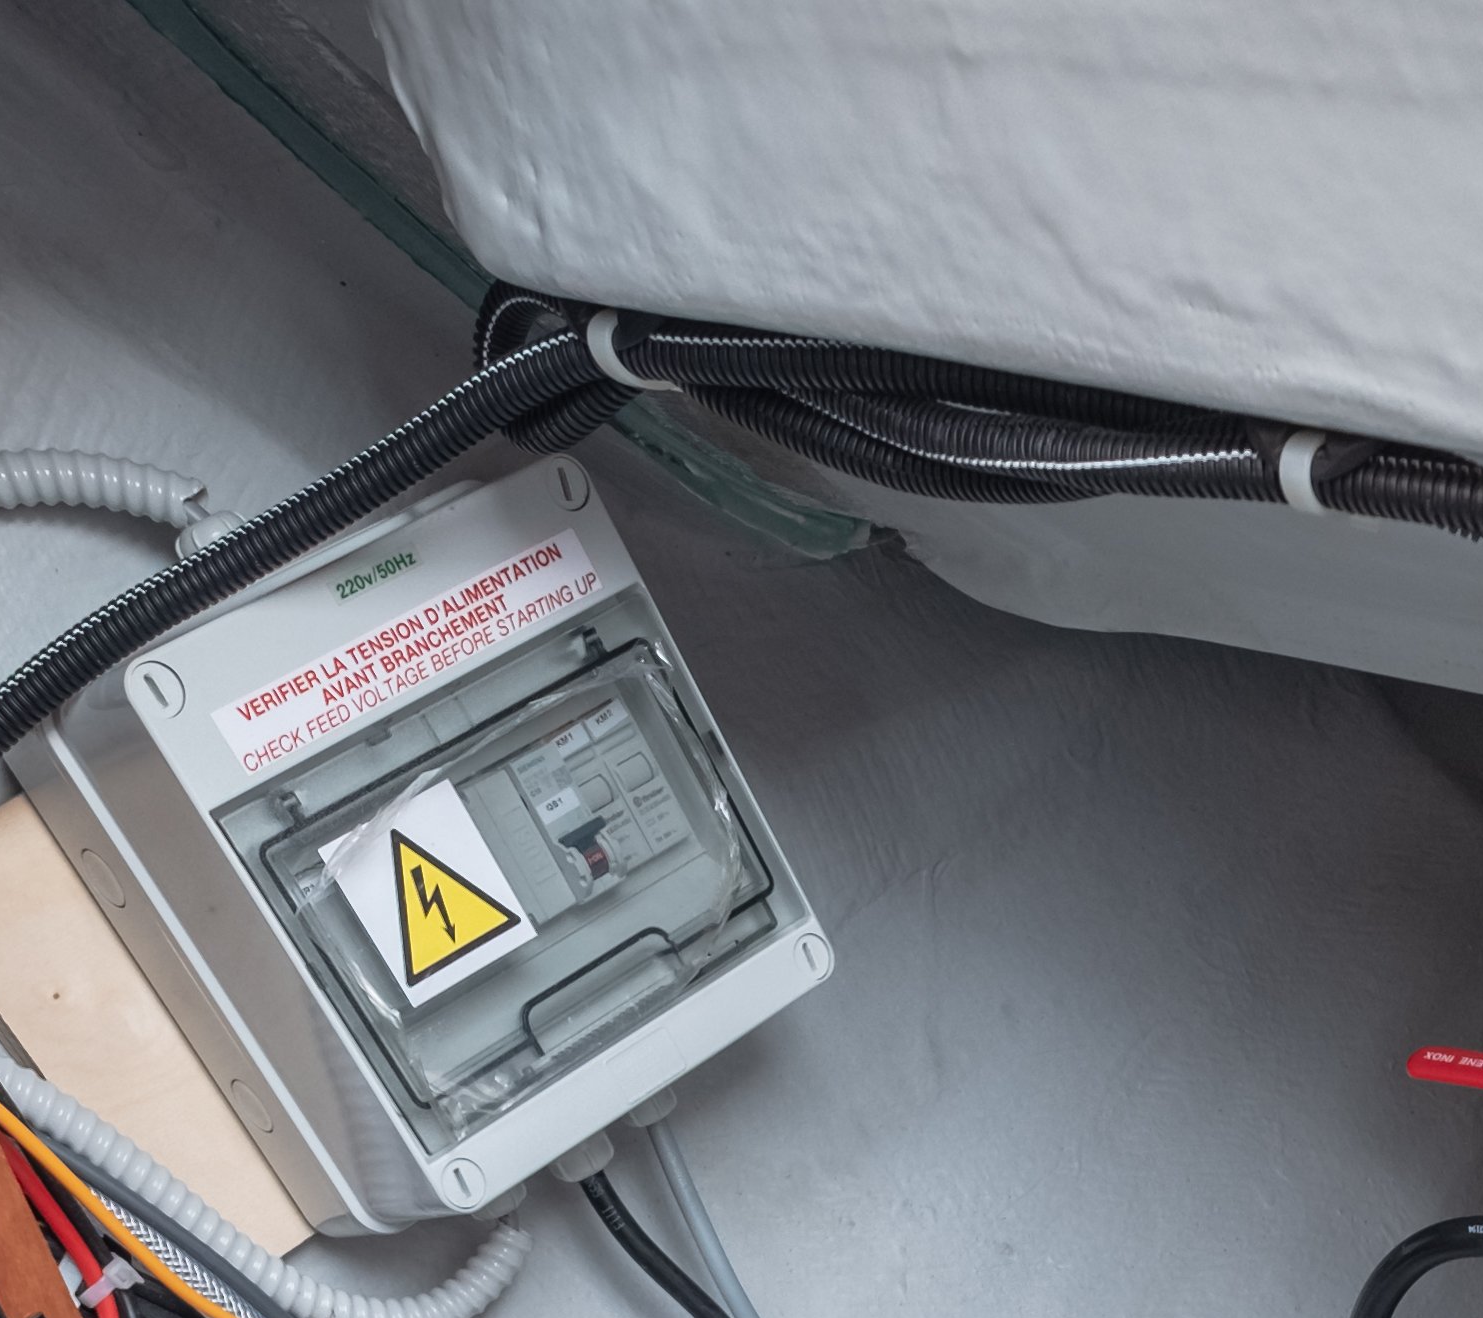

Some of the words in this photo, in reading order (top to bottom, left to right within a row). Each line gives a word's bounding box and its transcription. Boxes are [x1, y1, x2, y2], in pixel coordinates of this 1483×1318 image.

[335, 549, 417, 599] 220v/50Hz
[237, 668, 321, 723] VERIFIER
[320, 654, 346, 680] LA
[345, 614, 425, 666] TENSION
[424, 542, 563, 626] D'ALIMENTATION
[241, 727, 307, 773] CHECK
[305, 702, 352, 740] FEED
[351, 661, 430, 715] VOLTAGE
[429, 626, 496, 673] BEFORE
[495, 583, 575, 638] STARTING
[573, 570, 600, 597] UP
[319, 663, 379, 705] AVANT
[380, 594, 510, 674] BRANCHEMENT
[555, 731, 574, 748] KM1
[1423, 1050, 1454, 1062] INOX
